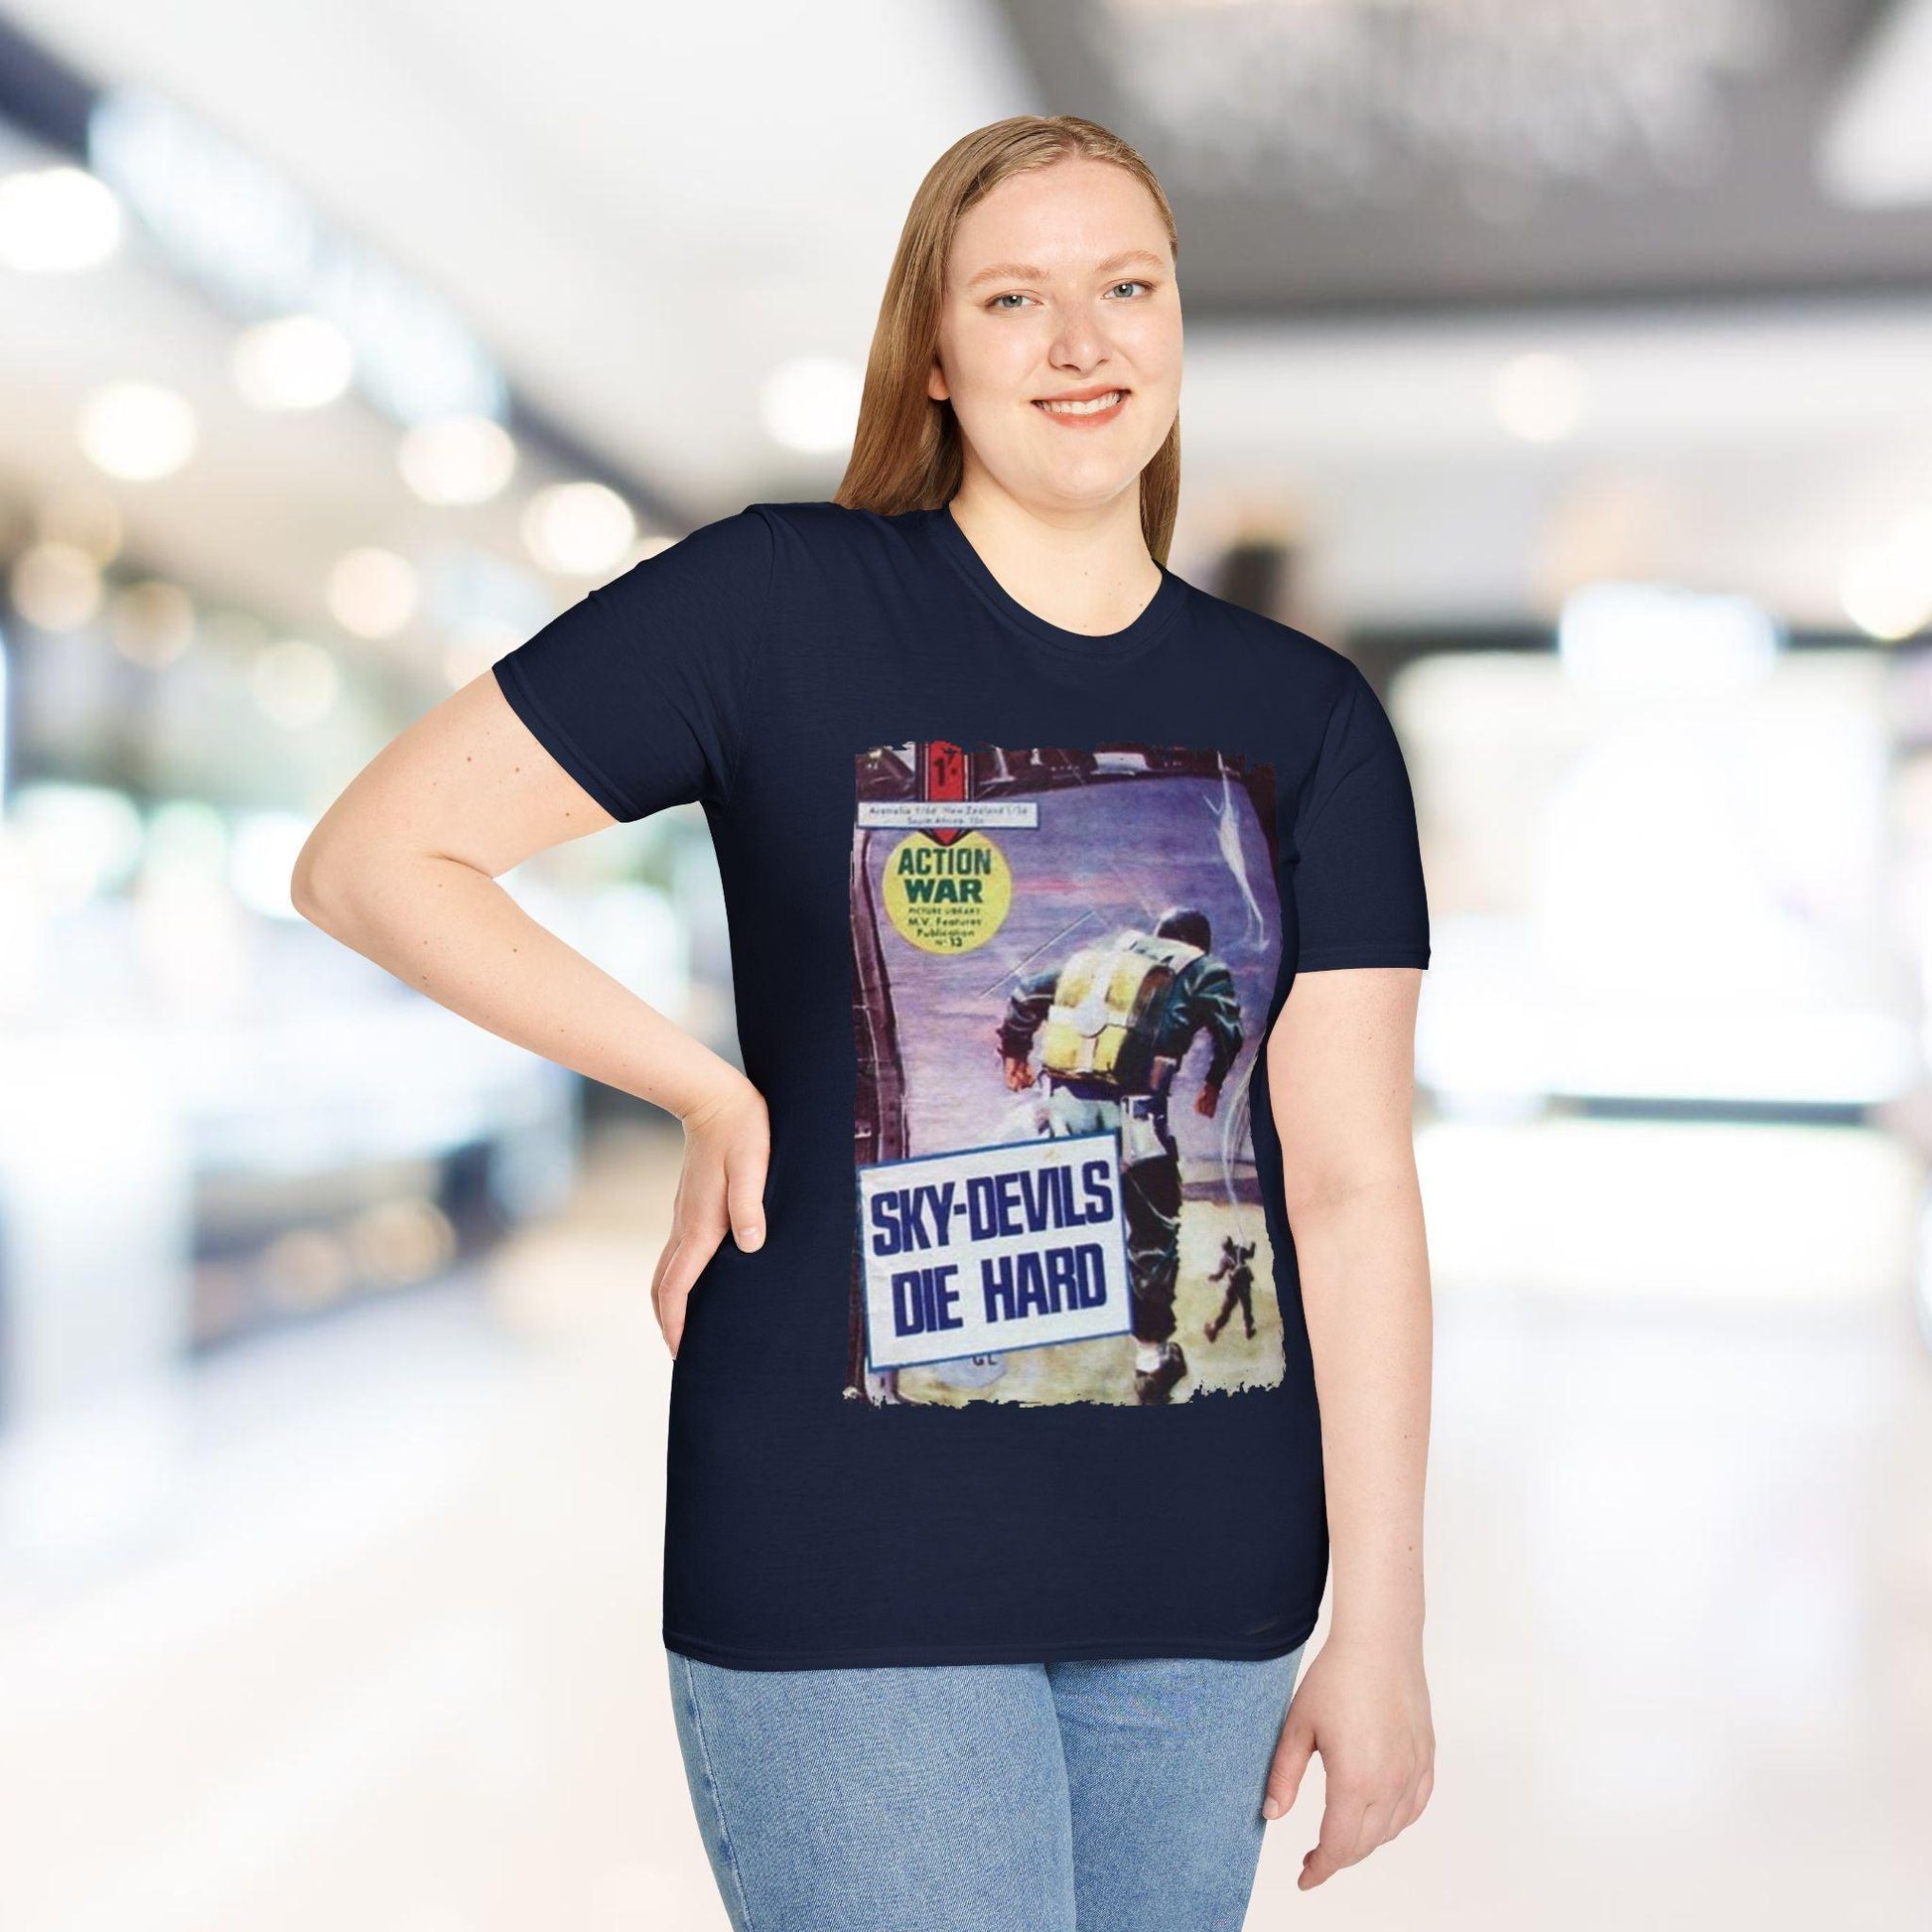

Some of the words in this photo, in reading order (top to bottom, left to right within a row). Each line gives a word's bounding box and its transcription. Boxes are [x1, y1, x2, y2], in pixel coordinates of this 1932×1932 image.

[965, 806, 1004, 815] Zealand
[897, 848, 991, 876] ACTION
[904, 879, 983, 903] WAR
[916, 928, 975, 937] Publication
[936, 916, 981, 926] Features
[870, 1160, 1114, 1257] SKY-DEVILS
[892, 1264, 963, 1337] DIE
[981, 1242, 1108, 1323] HARD
